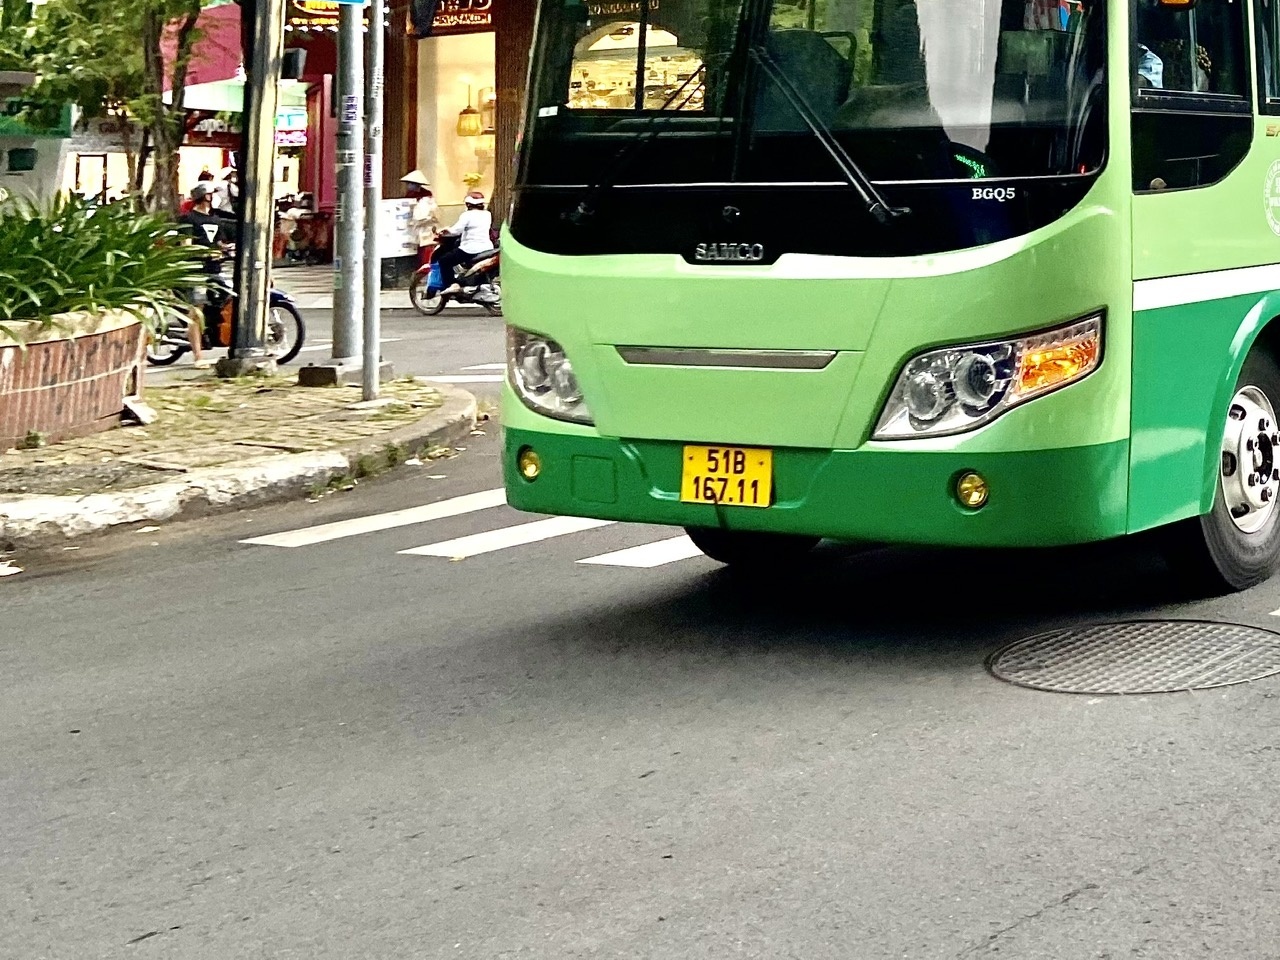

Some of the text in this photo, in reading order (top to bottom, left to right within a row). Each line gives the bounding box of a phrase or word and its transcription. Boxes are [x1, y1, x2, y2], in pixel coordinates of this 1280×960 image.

[971, 187, 1016, 202] BGQ5
[695, 242, 764, 261] SAMCO
[707, 449, 746, 474] 51B
[693, 475, 759, 504] 167.11
